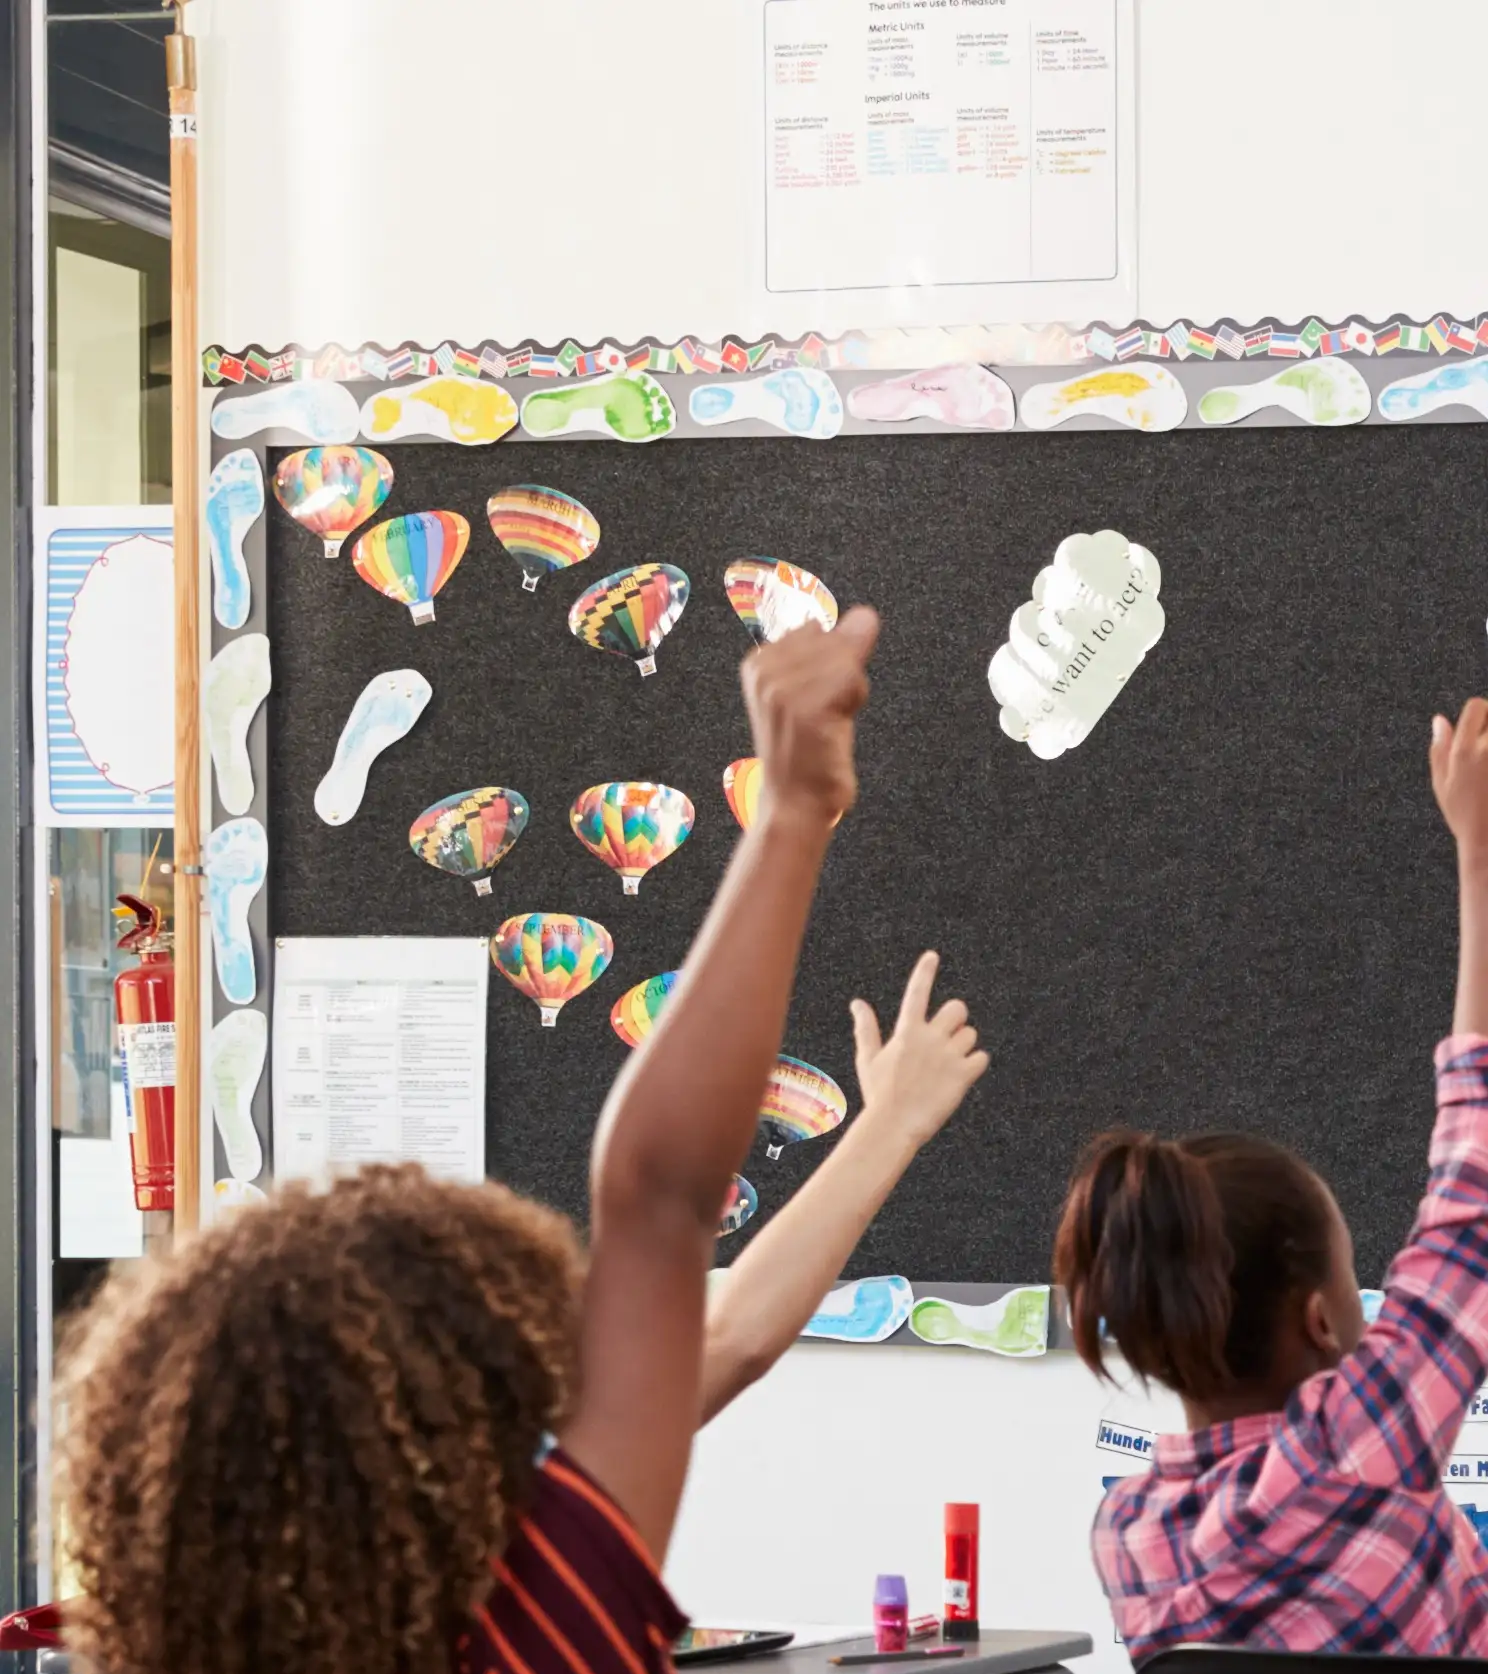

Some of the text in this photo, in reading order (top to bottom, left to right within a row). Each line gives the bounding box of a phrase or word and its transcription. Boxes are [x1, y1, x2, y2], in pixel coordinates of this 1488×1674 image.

[869, 21, 925, 33] Metric Units
[864, 90, 931, 104] Imperial Units
[1051, 642, 1097, 695] want
[1091, 619, 1115, 643] to
[515, 922, 585, 936] SEPTEMBER
